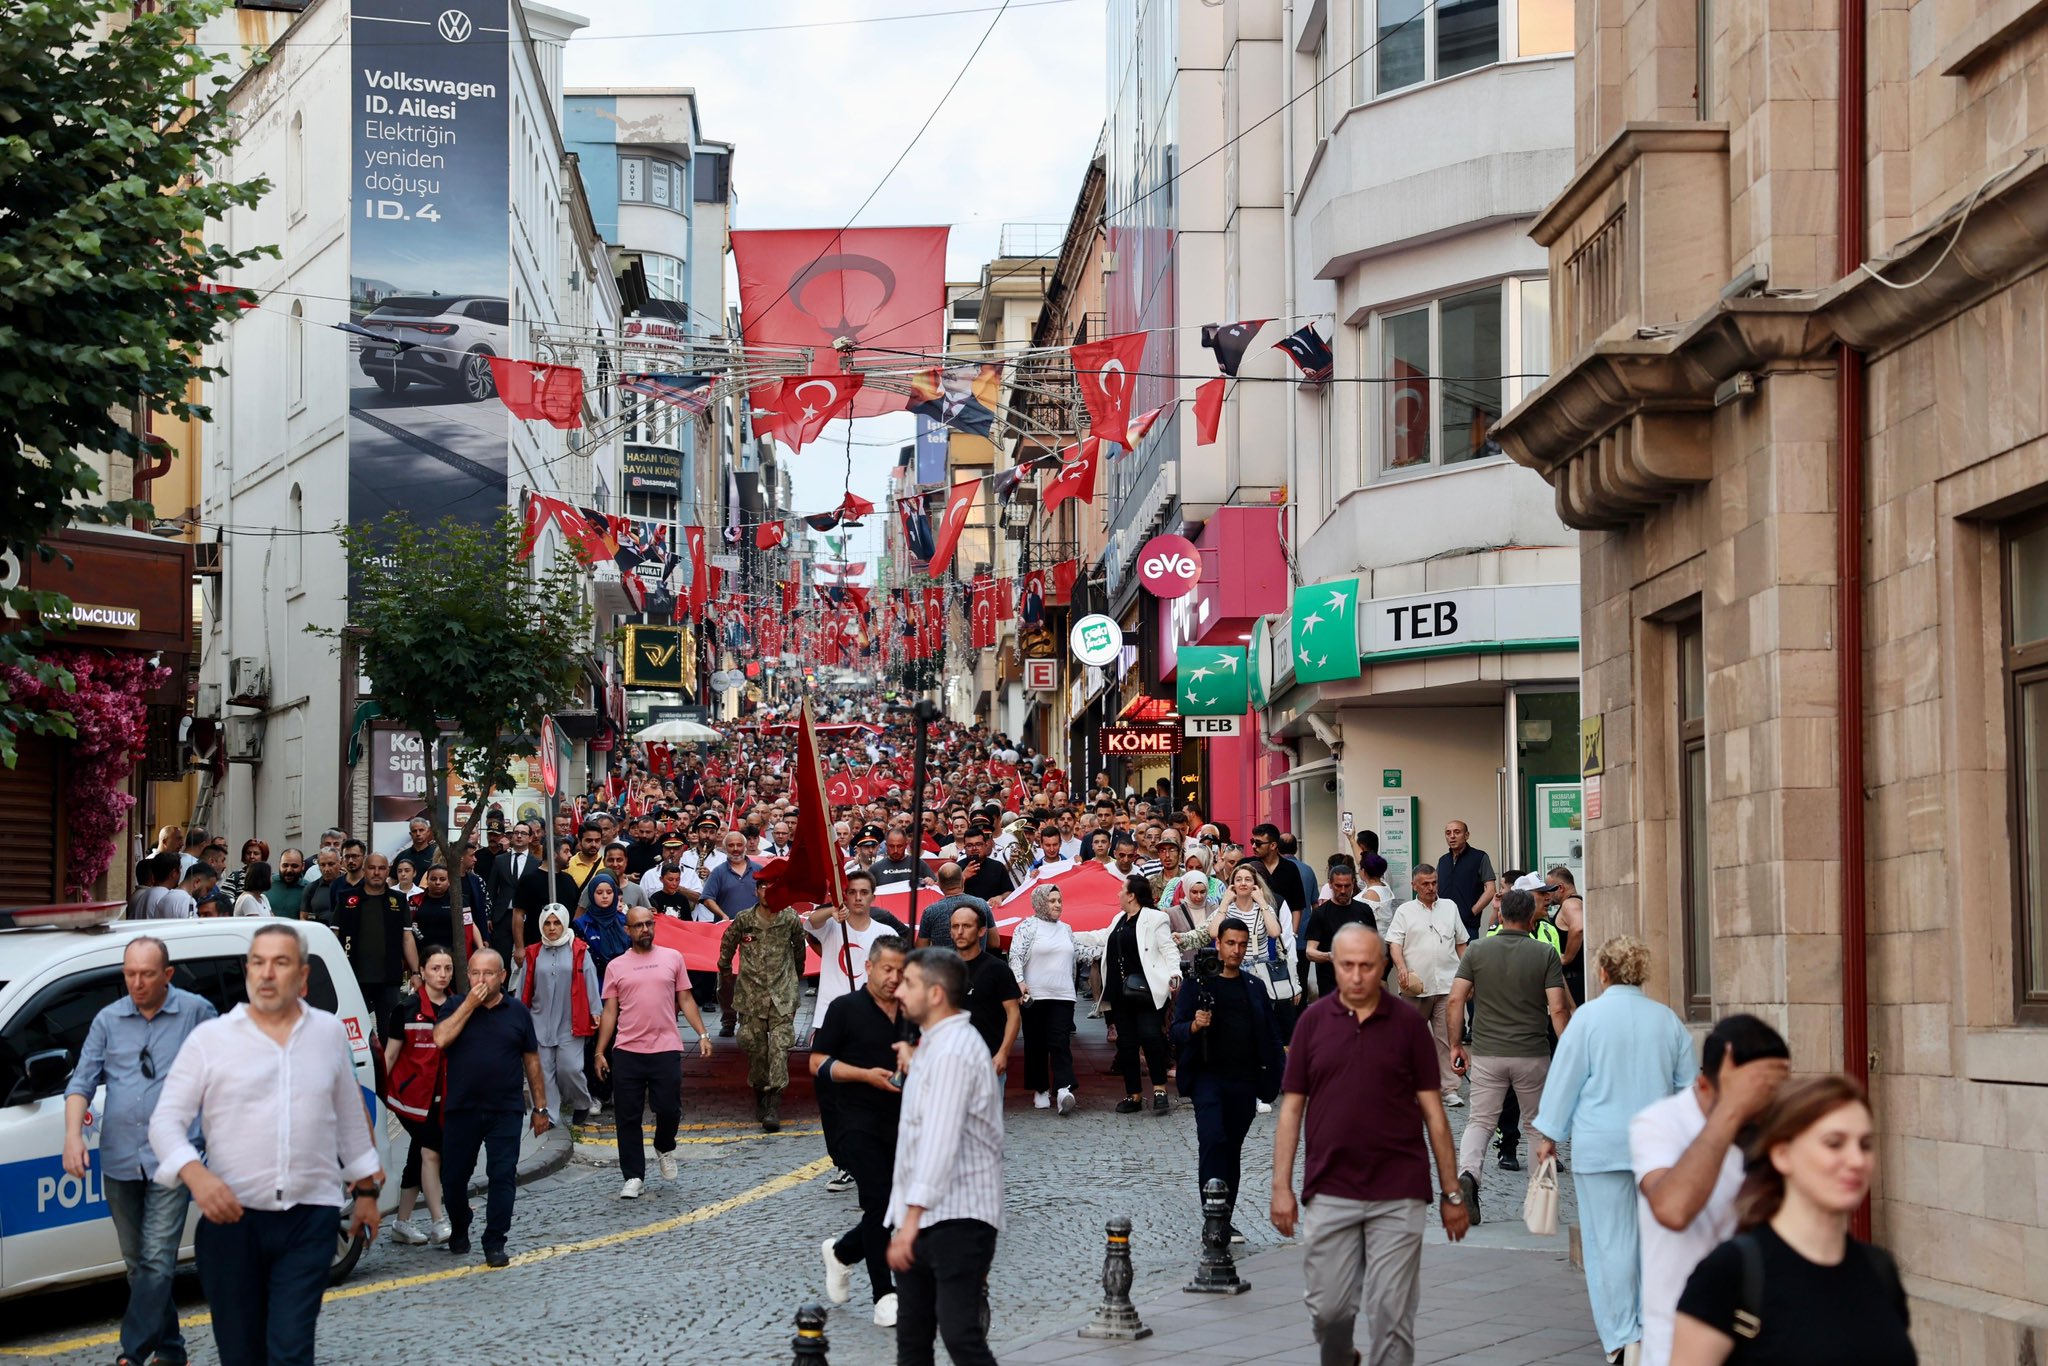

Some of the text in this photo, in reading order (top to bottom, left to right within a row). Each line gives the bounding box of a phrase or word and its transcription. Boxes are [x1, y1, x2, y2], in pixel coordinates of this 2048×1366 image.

[364, 69, 496, 100] Volkswagen
[365, 95, 457, 120] ID. Ailesi
[366, 120, 456, 148] Elektriğin
[364, 149, 444, 169] yeniden
[365, 171, 440, 198] doğuşu
[626, 453, 657, 464] HASAN
[623, 465, 653, 475] BAYAN
[636, 566, 660, 577] AVUKAT
[1144, 553, 1196, 579] eve
[1387, 601, 1458, 641] TEB
[1277, 638, 1288, 676] TEB
[1034, 665, 1050, 684] E
[1192, 719, 1232, 732] TEB
[1108, 730, 1172, 750] KÖME
